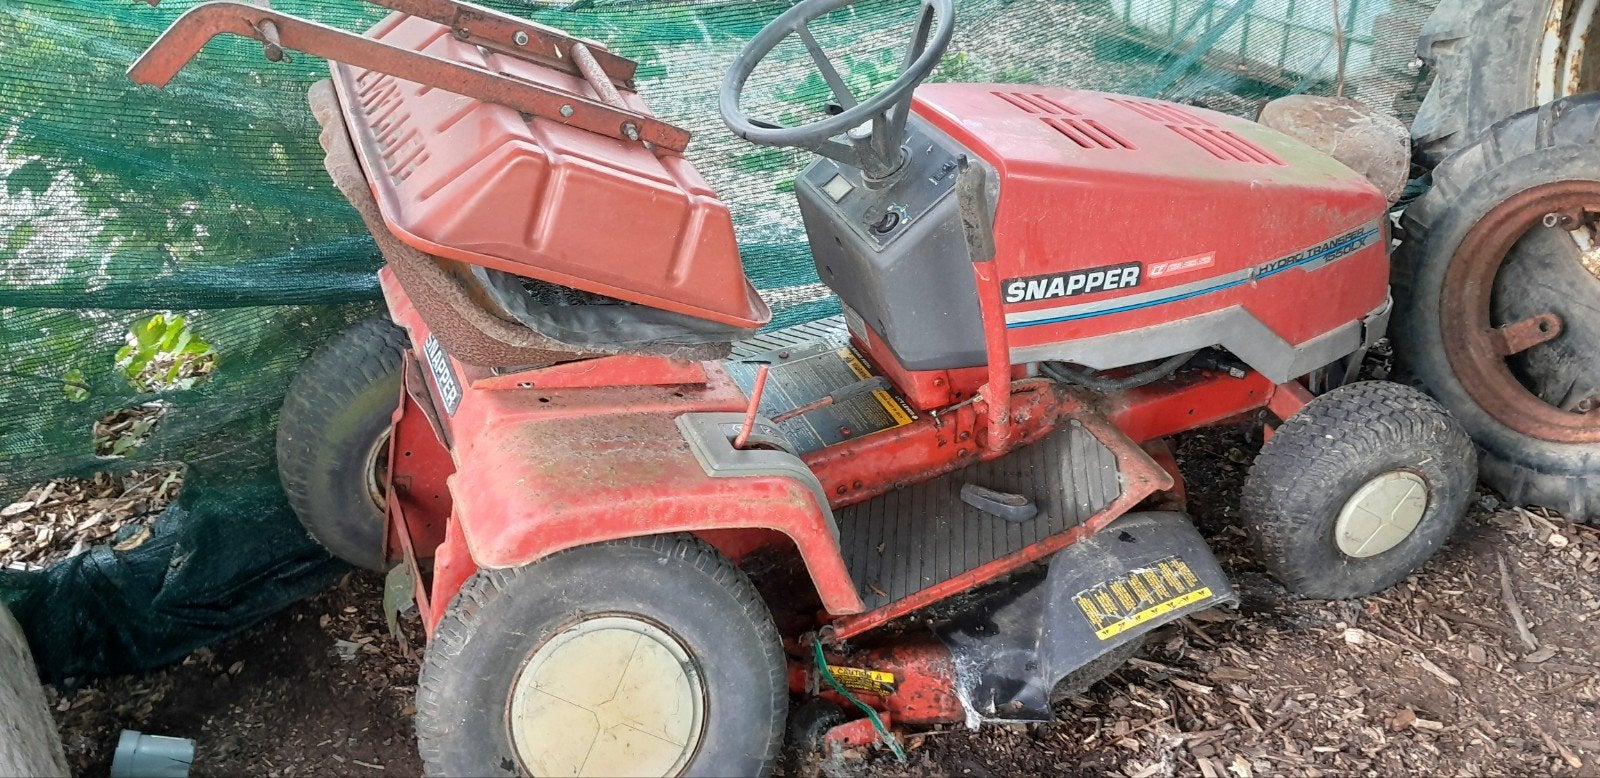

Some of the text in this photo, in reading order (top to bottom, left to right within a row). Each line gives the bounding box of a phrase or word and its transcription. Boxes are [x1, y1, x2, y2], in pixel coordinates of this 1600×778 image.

[1258, 227, 1365, 275] HYDRO TRANSFER
[1005, 265, 1141, 303] SNAPPER
[425, 332, 457, 408] SNAPPER
